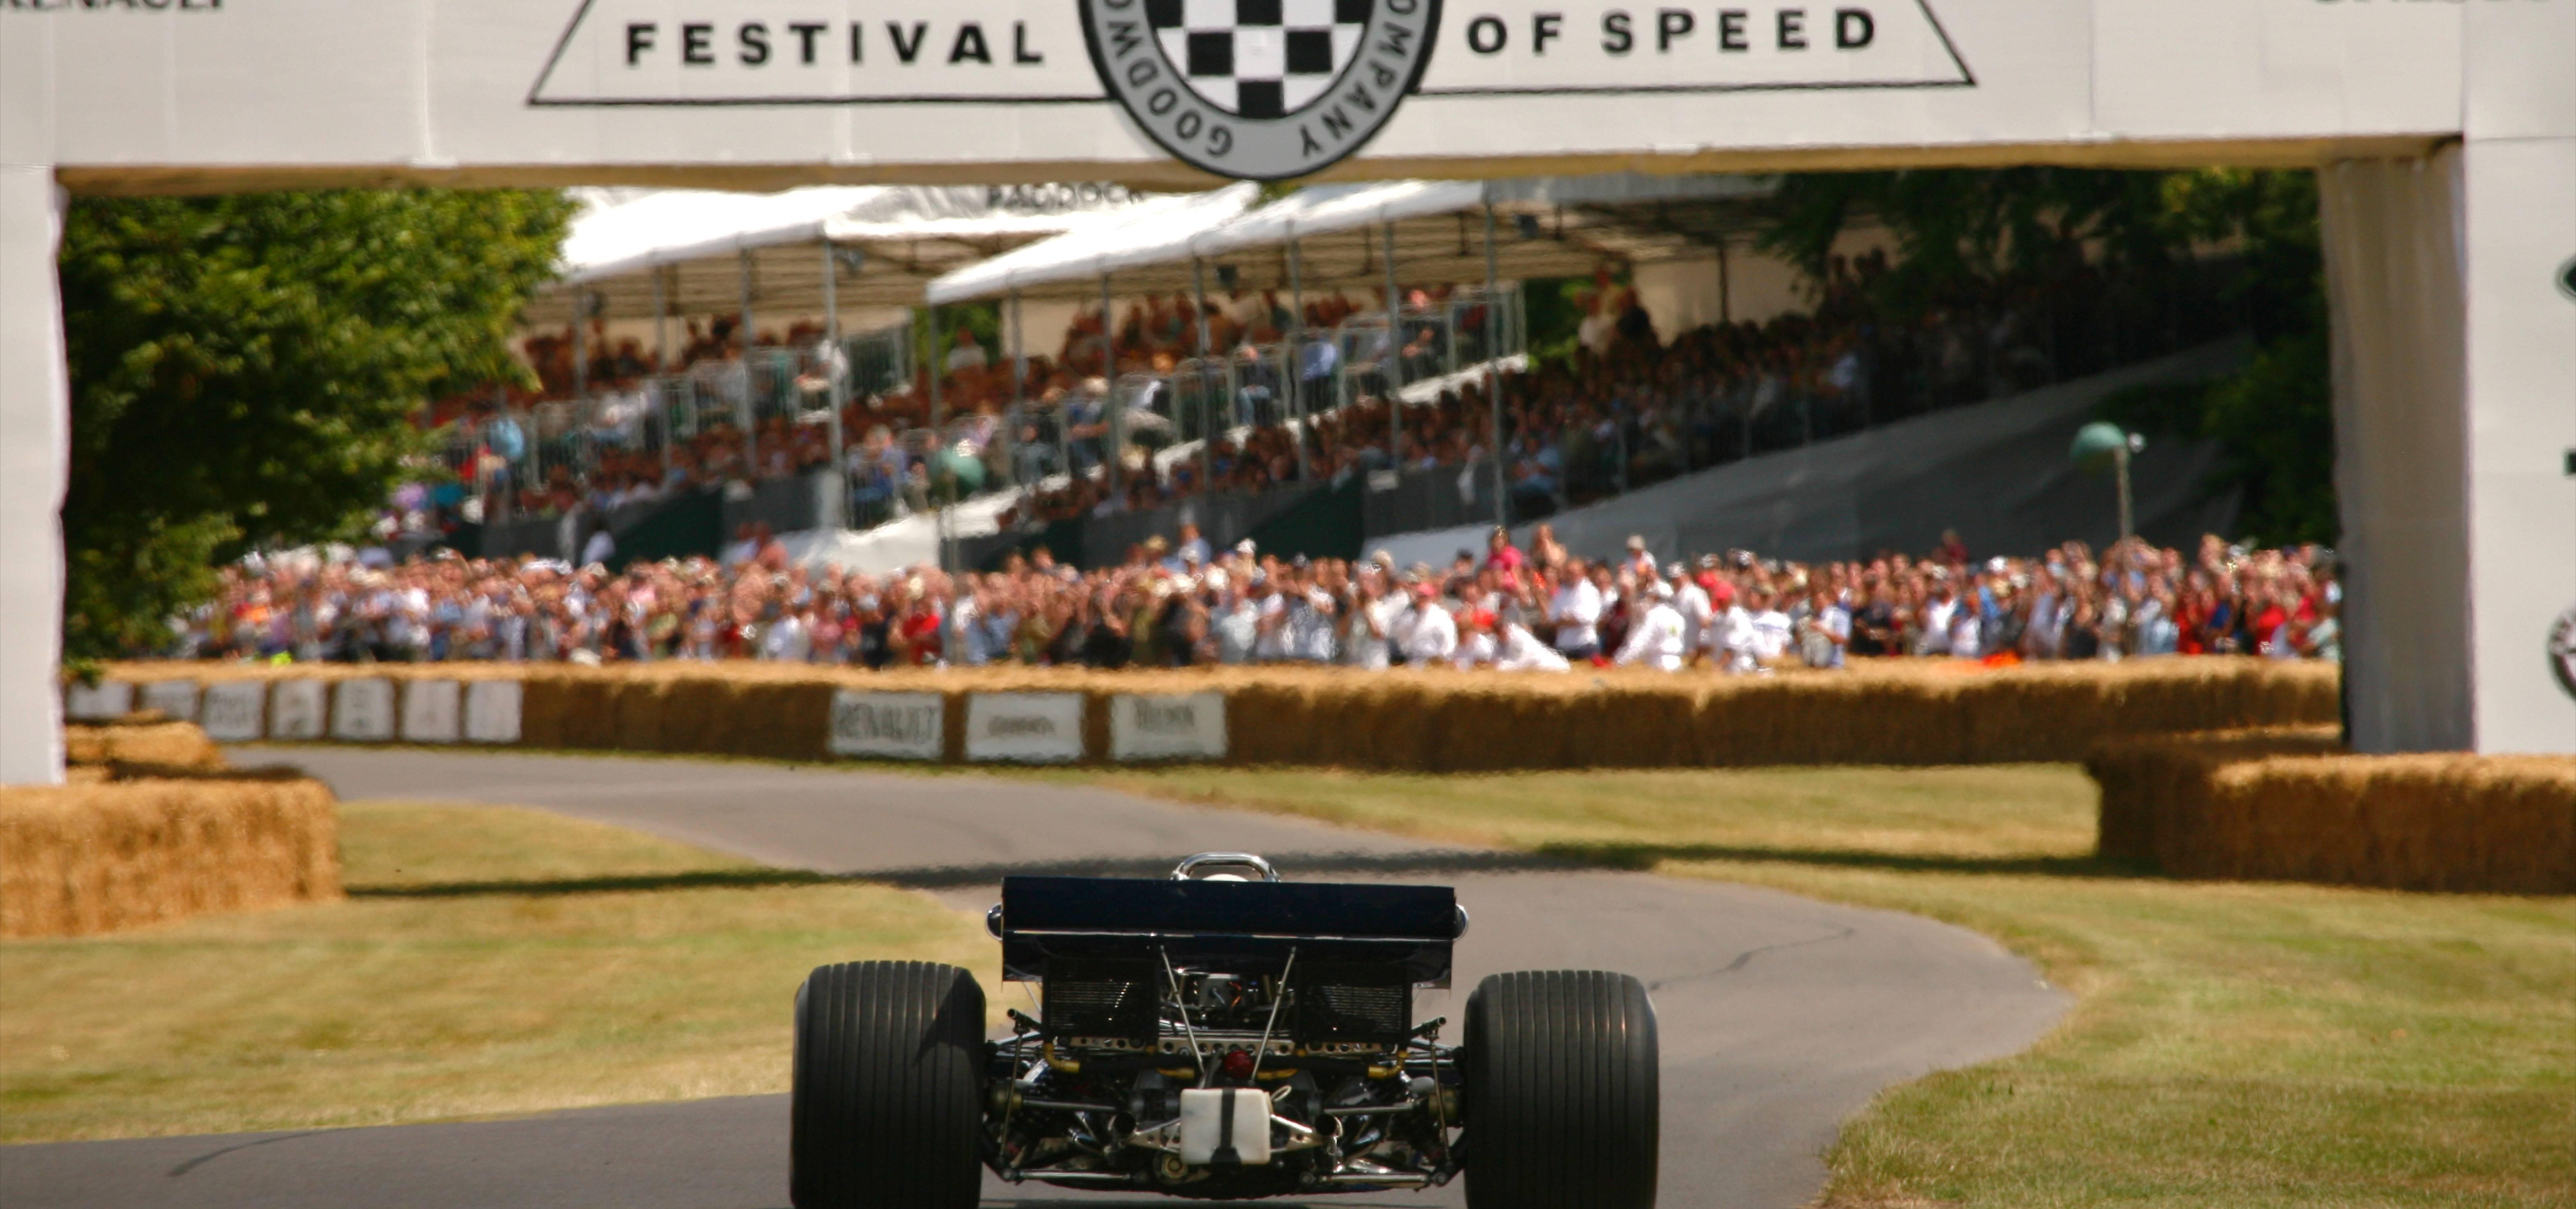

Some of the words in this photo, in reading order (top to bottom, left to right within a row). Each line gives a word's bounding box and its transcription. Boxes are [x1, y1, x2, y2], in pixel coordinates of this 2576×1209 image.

[624, 21, 1044, 66] FESTIVAL
[1466, 14, 1564, 55] OF
[1600, 9, 1875, 57] SPEED
